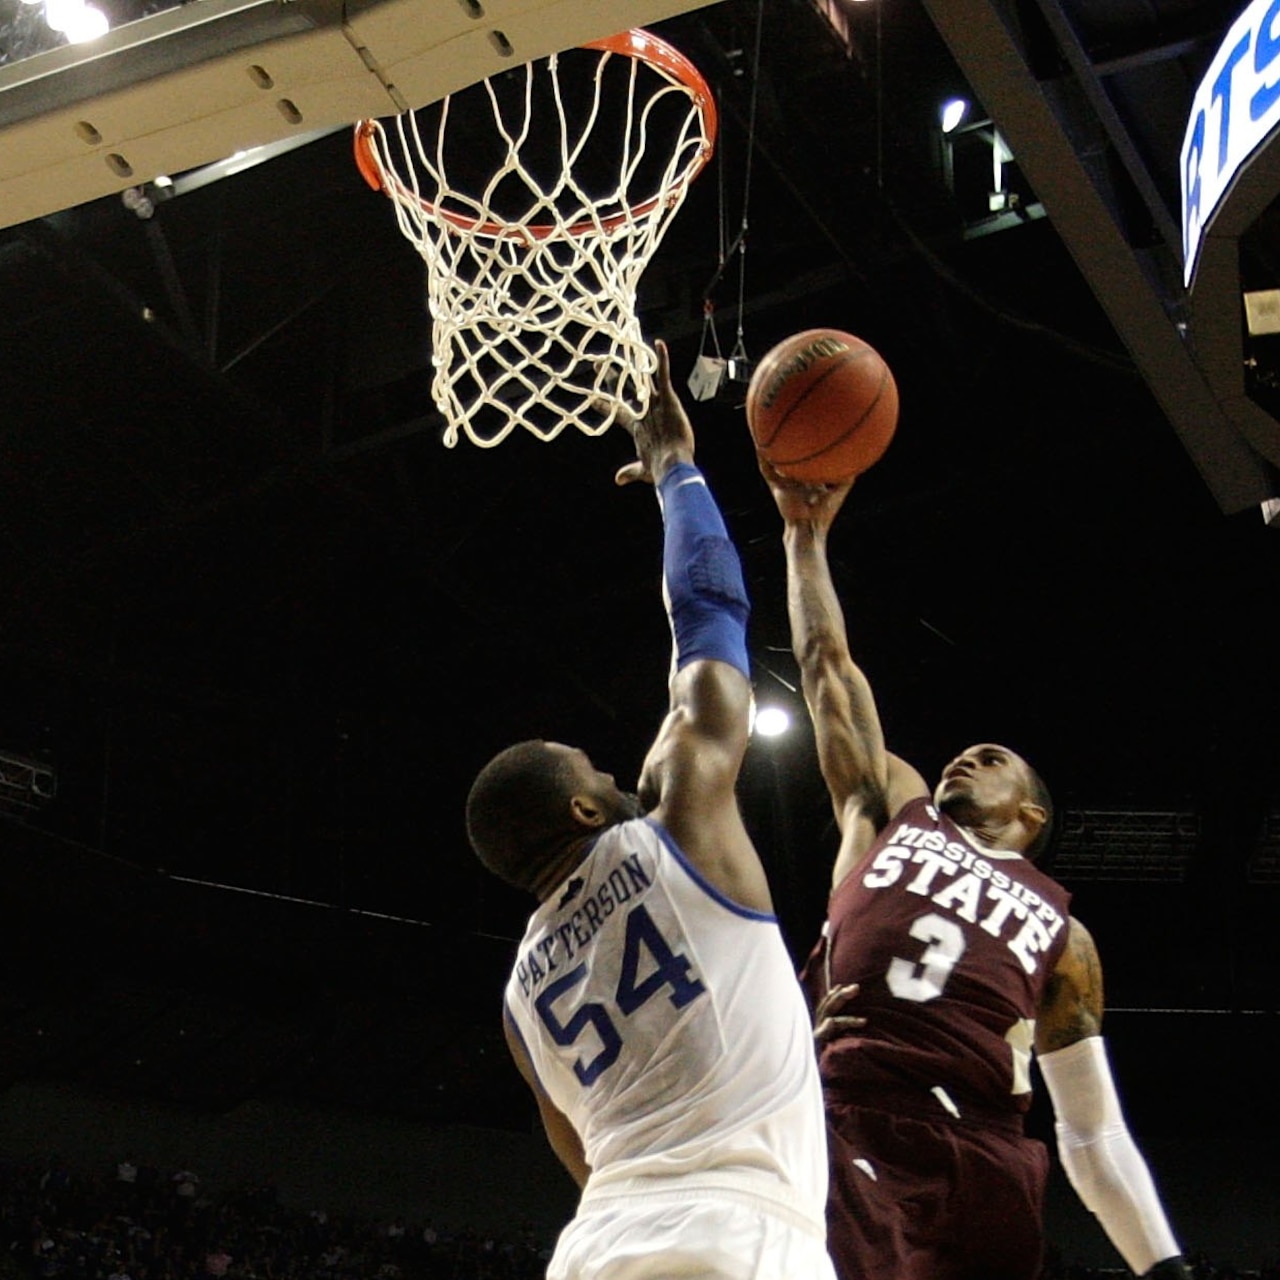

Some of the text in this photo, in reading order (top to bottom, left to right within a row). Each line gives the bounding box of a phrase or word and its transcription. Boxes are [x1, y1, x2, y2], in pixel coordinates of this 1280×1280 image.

[516, 852, 650, 998] PATTERSON
[863, 845, 1054, 974] STATE
[888, 822, 1062, 940] MISSISSIPPI
[535, 904, 707, 1087] 54
[885, 913, 966, 1002] 3
